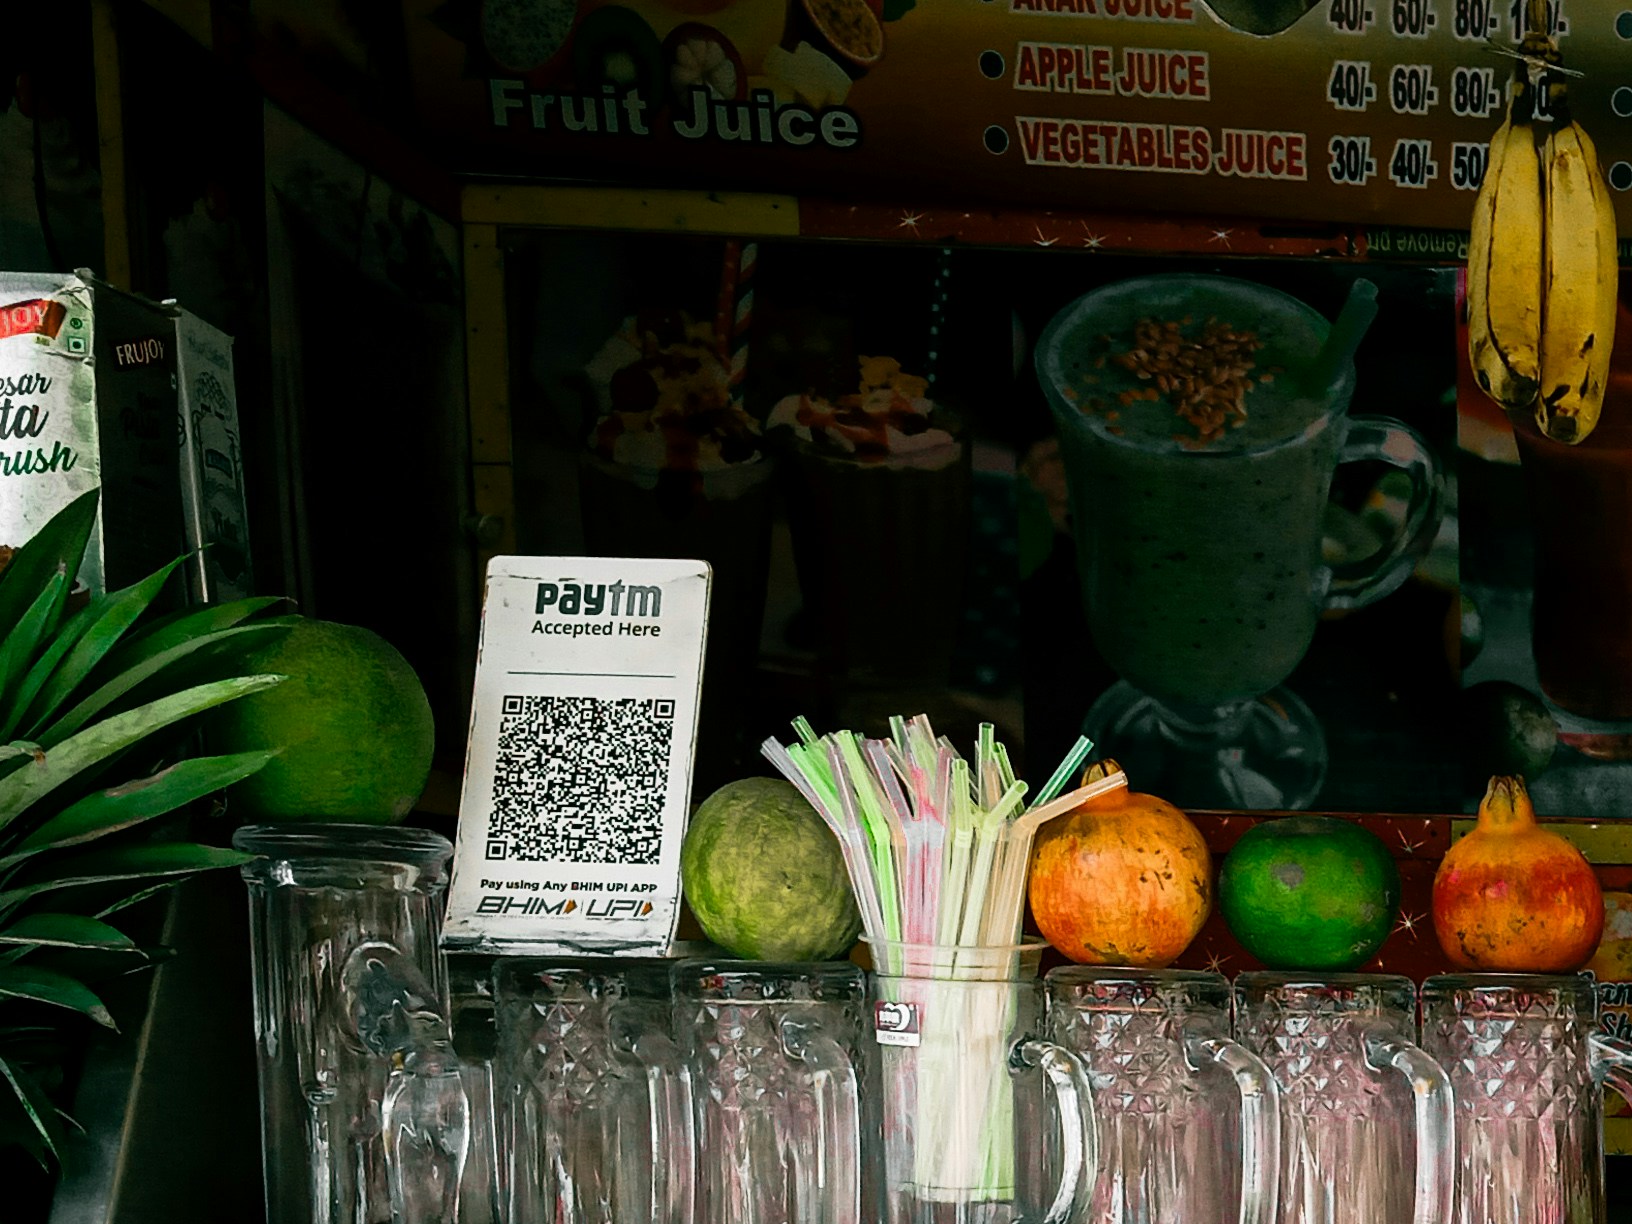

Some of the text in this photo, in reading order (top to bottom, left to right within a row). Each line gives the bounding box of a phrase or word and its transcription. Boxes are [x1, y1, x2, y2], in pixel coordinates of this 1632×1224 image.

[1018, 46, 1111, 90] APPLE
[1120, 52, 1206, 96] JUICE
[1331, 65, 1373, 106] 40/-
[1393, 68, 1435, 110] 60/-
[1454, 70, 1496, 113] 80/-
[490, 79, 859, 147] Fruit Juice
[1021, 121, 1210, 170] VEGETABLES
[1218, 133, 1305, 176] JUICE
[1331, 140, 1373, 181] 30/-
[1392, 143, 1434, 185] 40/-
[1397, 232, 1468, 259] Remove
[535, 579, 661, 617] paytm
[532, 620, 660, 638] Accepted Here
[481, 879, 657, 892] Pay using Any BHIM UPI APP
[476, 896, 644, 917] BHIM UPI
